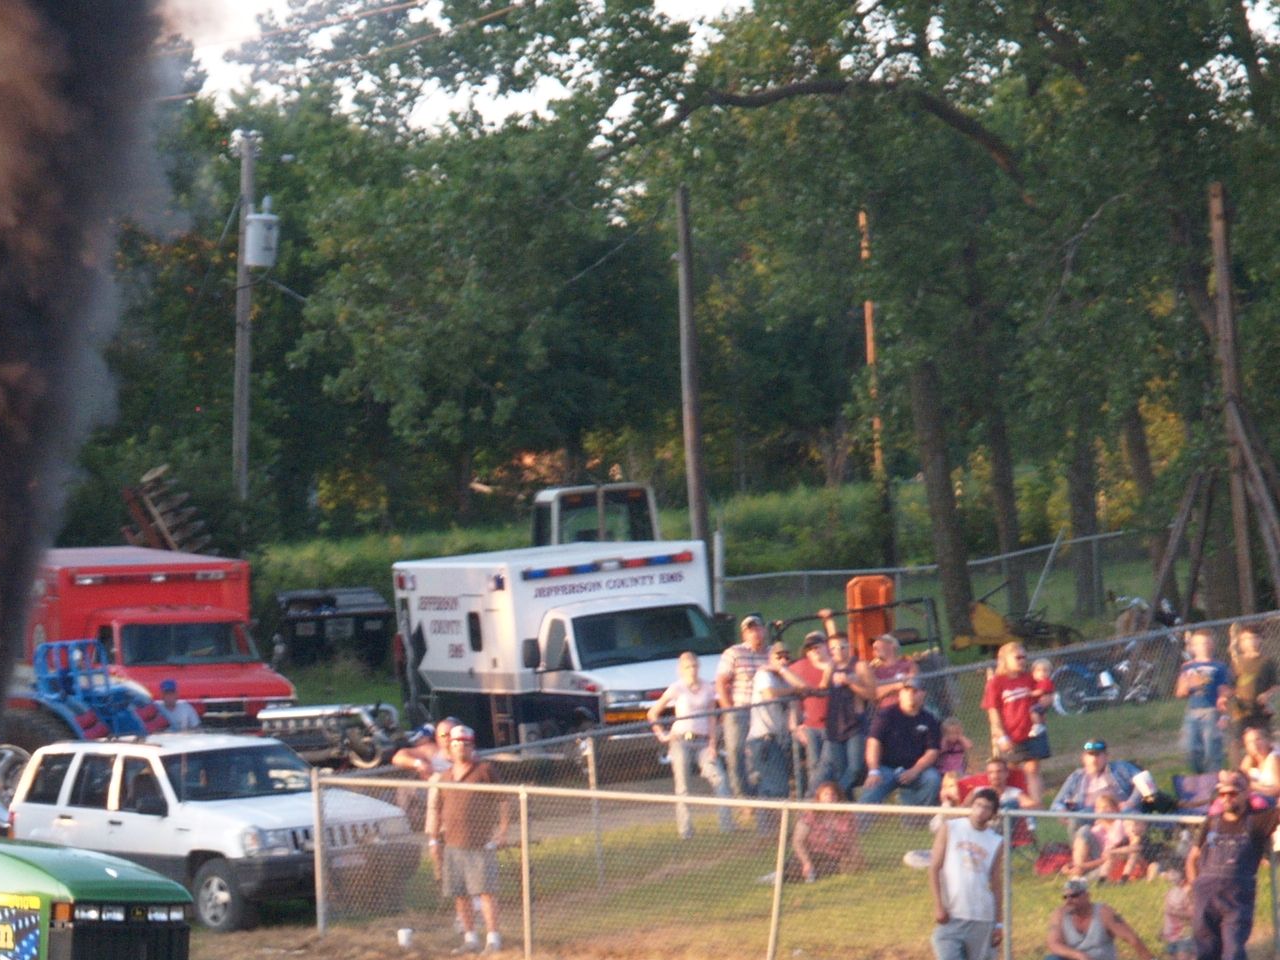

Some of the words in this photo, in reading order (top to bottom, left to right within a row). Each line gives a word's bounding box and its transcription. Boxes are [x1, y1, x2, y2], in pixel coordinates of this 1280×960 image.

[534, 580, 602, 598] JEFFERSON
[605, 575, 655, 590] COUNTY
[659, 570, 685, 585] EMS
